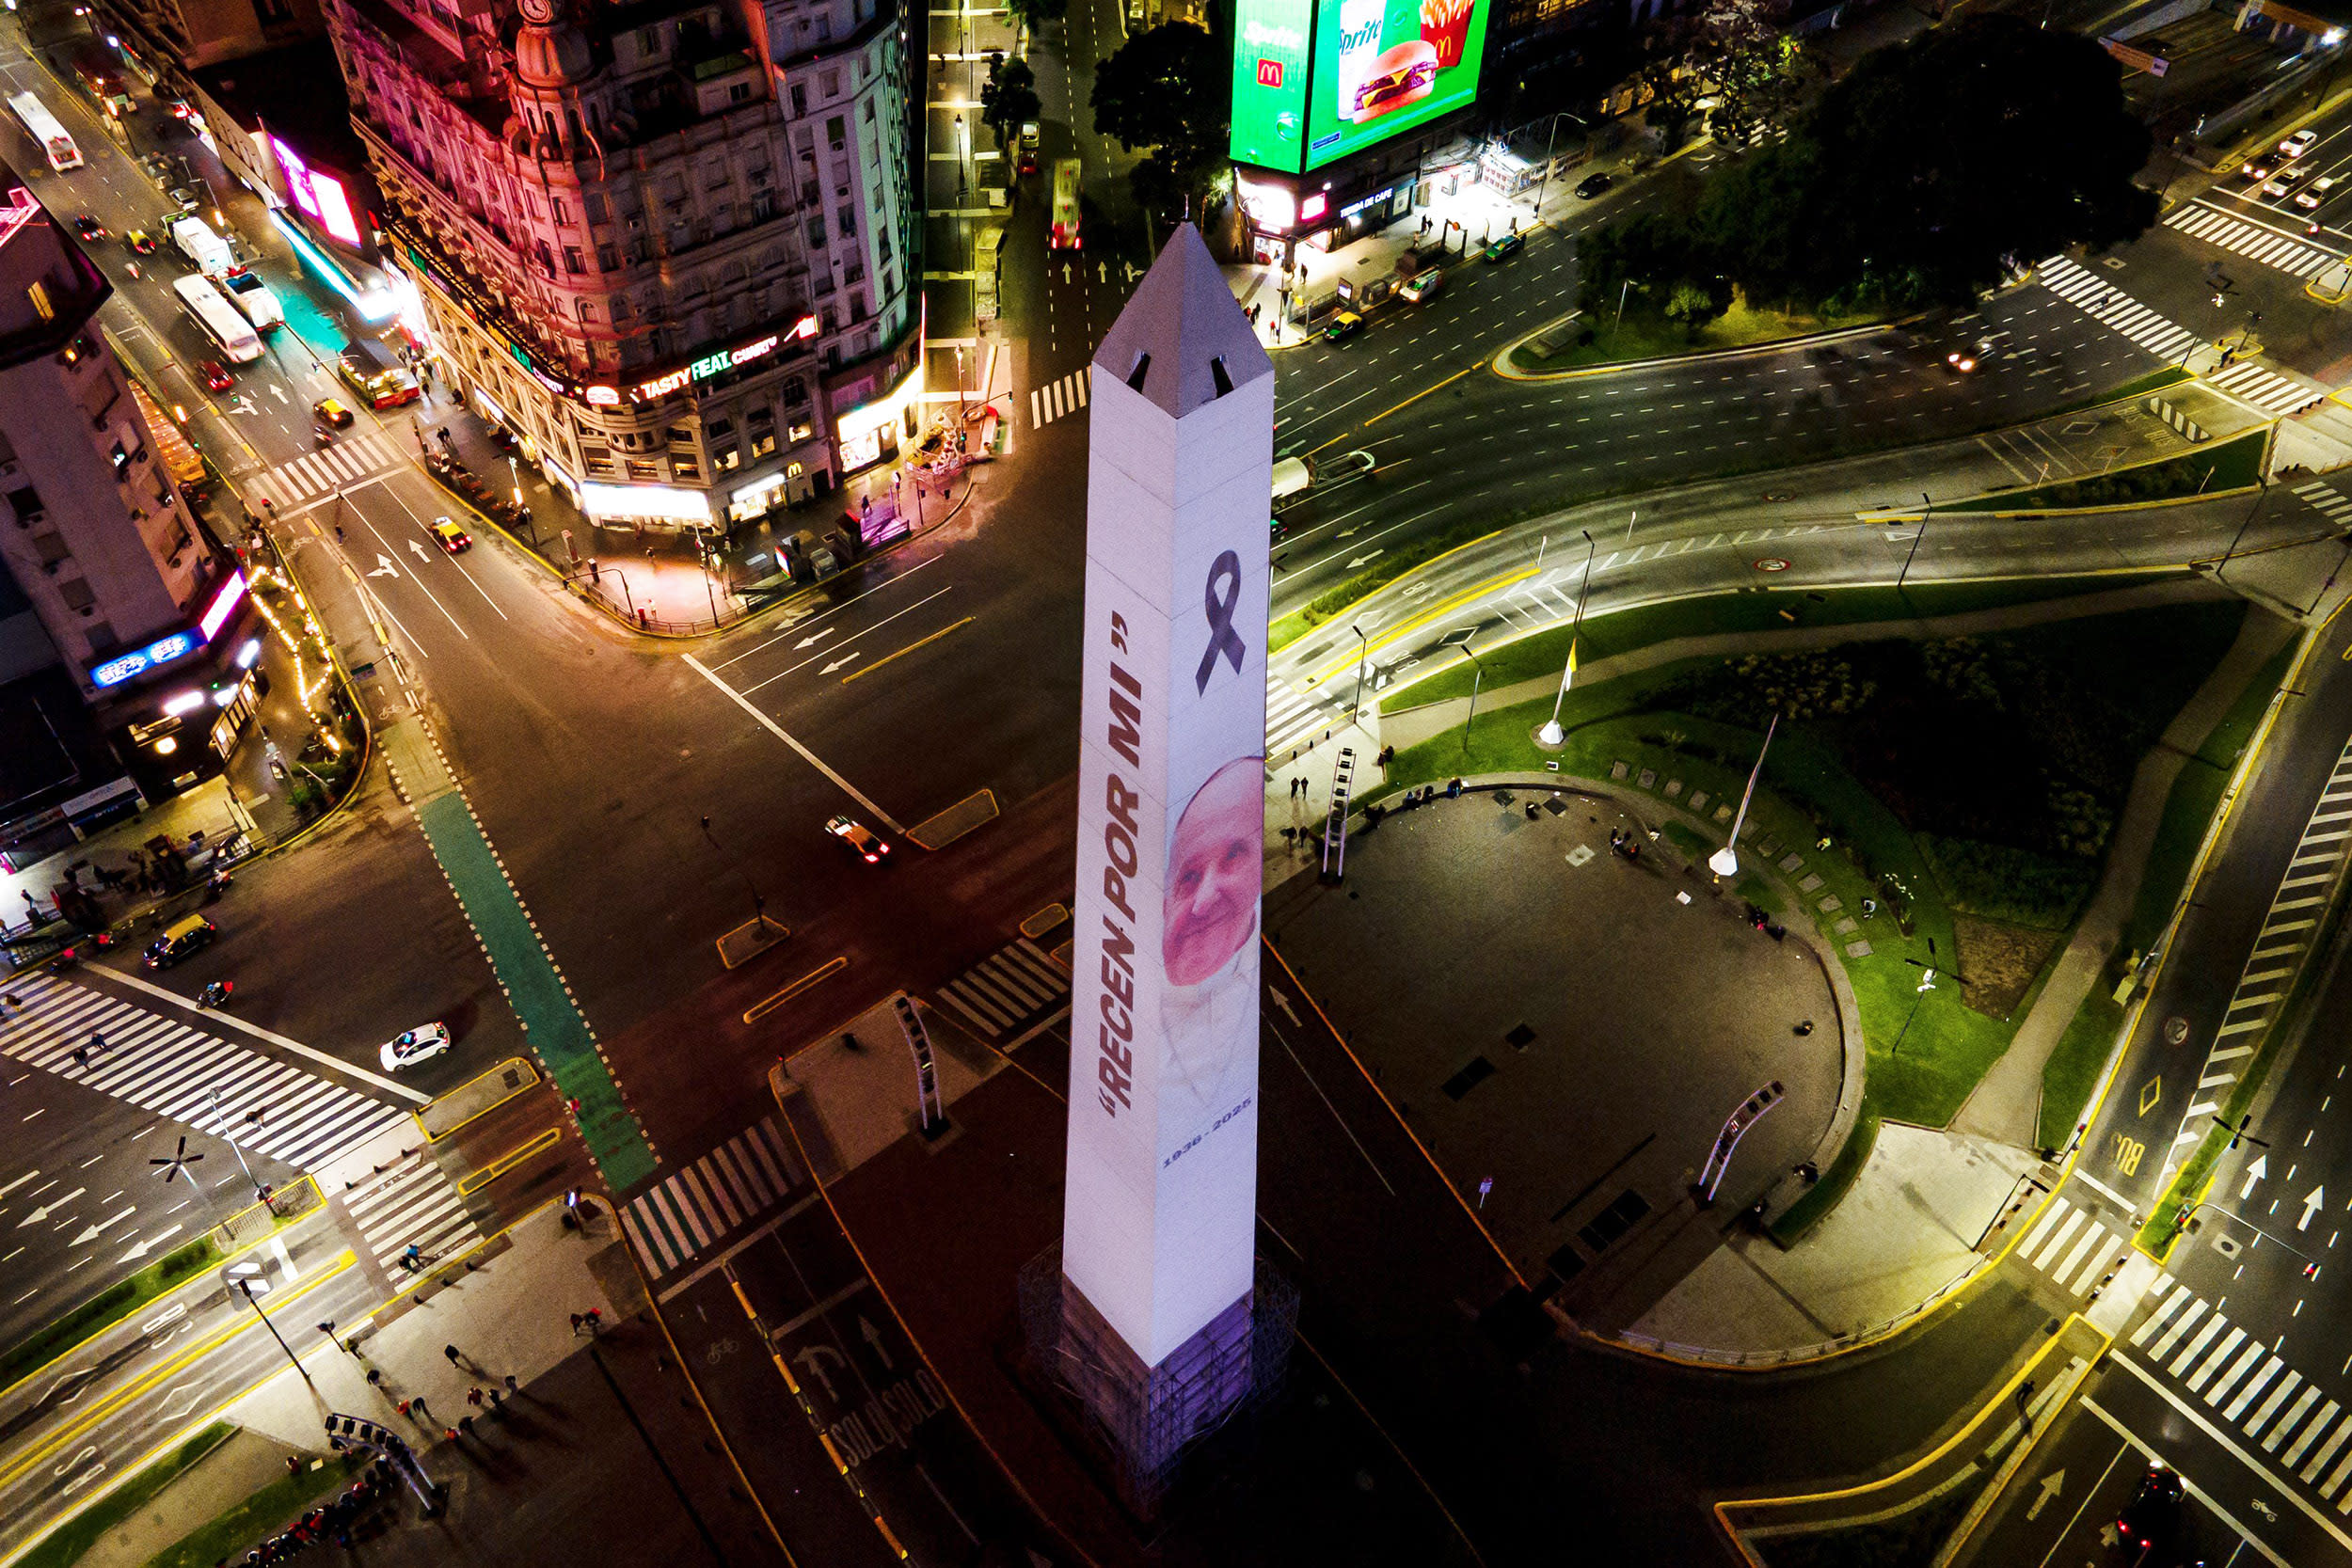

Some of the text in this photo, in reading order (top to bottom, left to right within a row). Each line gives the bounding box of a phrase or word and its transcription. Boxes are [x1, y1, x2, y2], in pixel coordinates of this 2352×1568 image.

[1364, 196, 1375, 208] DE
[641, 367, 691, 399] TASTY
[1104, 772, 1140, 925] POR
[1163, 1133, 1202, 1168] 1936
[1211, 1096, 1252, 1132] 2025
